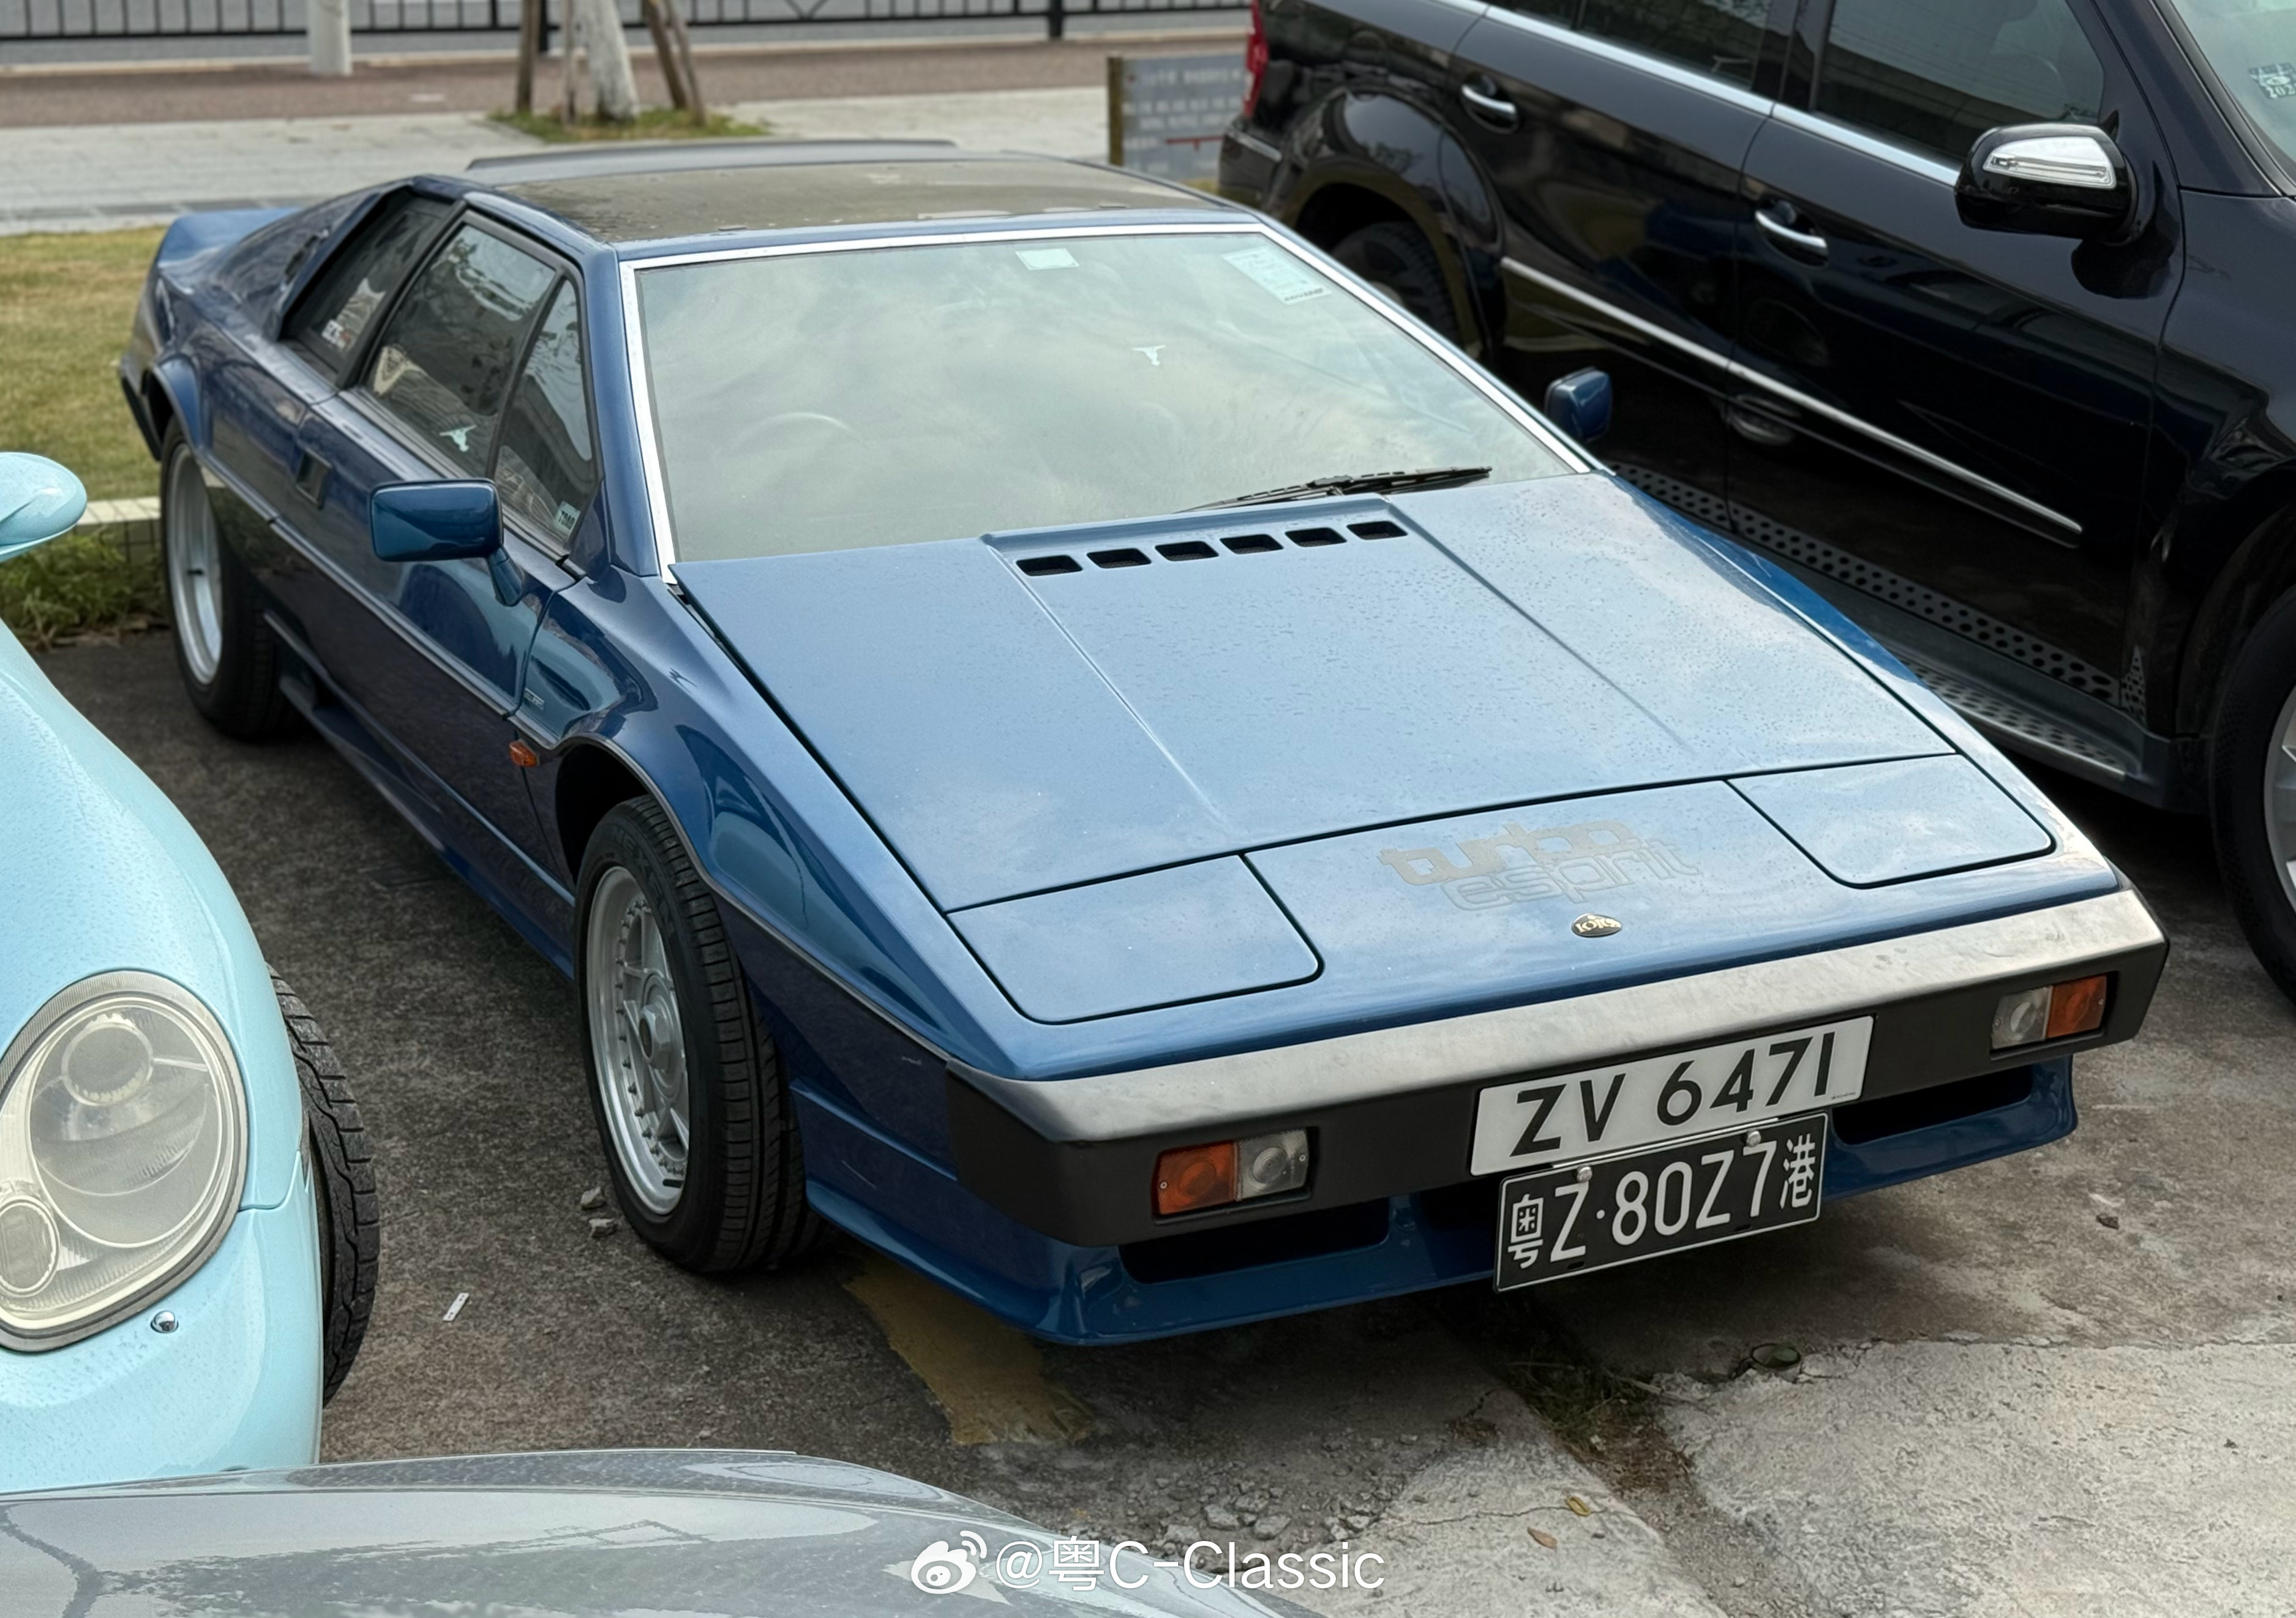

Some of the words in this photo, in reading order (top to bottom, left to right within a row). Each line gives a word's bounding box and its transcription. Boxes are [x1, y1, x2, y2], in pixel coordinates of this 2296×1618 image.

[2266, 84, 2296, 99] 202
[613, 825, 678, 939] NEXEN
[1377, 820, 1640, 886] turbo
[1441, 838, 1703, 911] esprit
[1510, 1073, 1627, 1157] ZV
[1656, 1032, 1836, 1126] 6471
